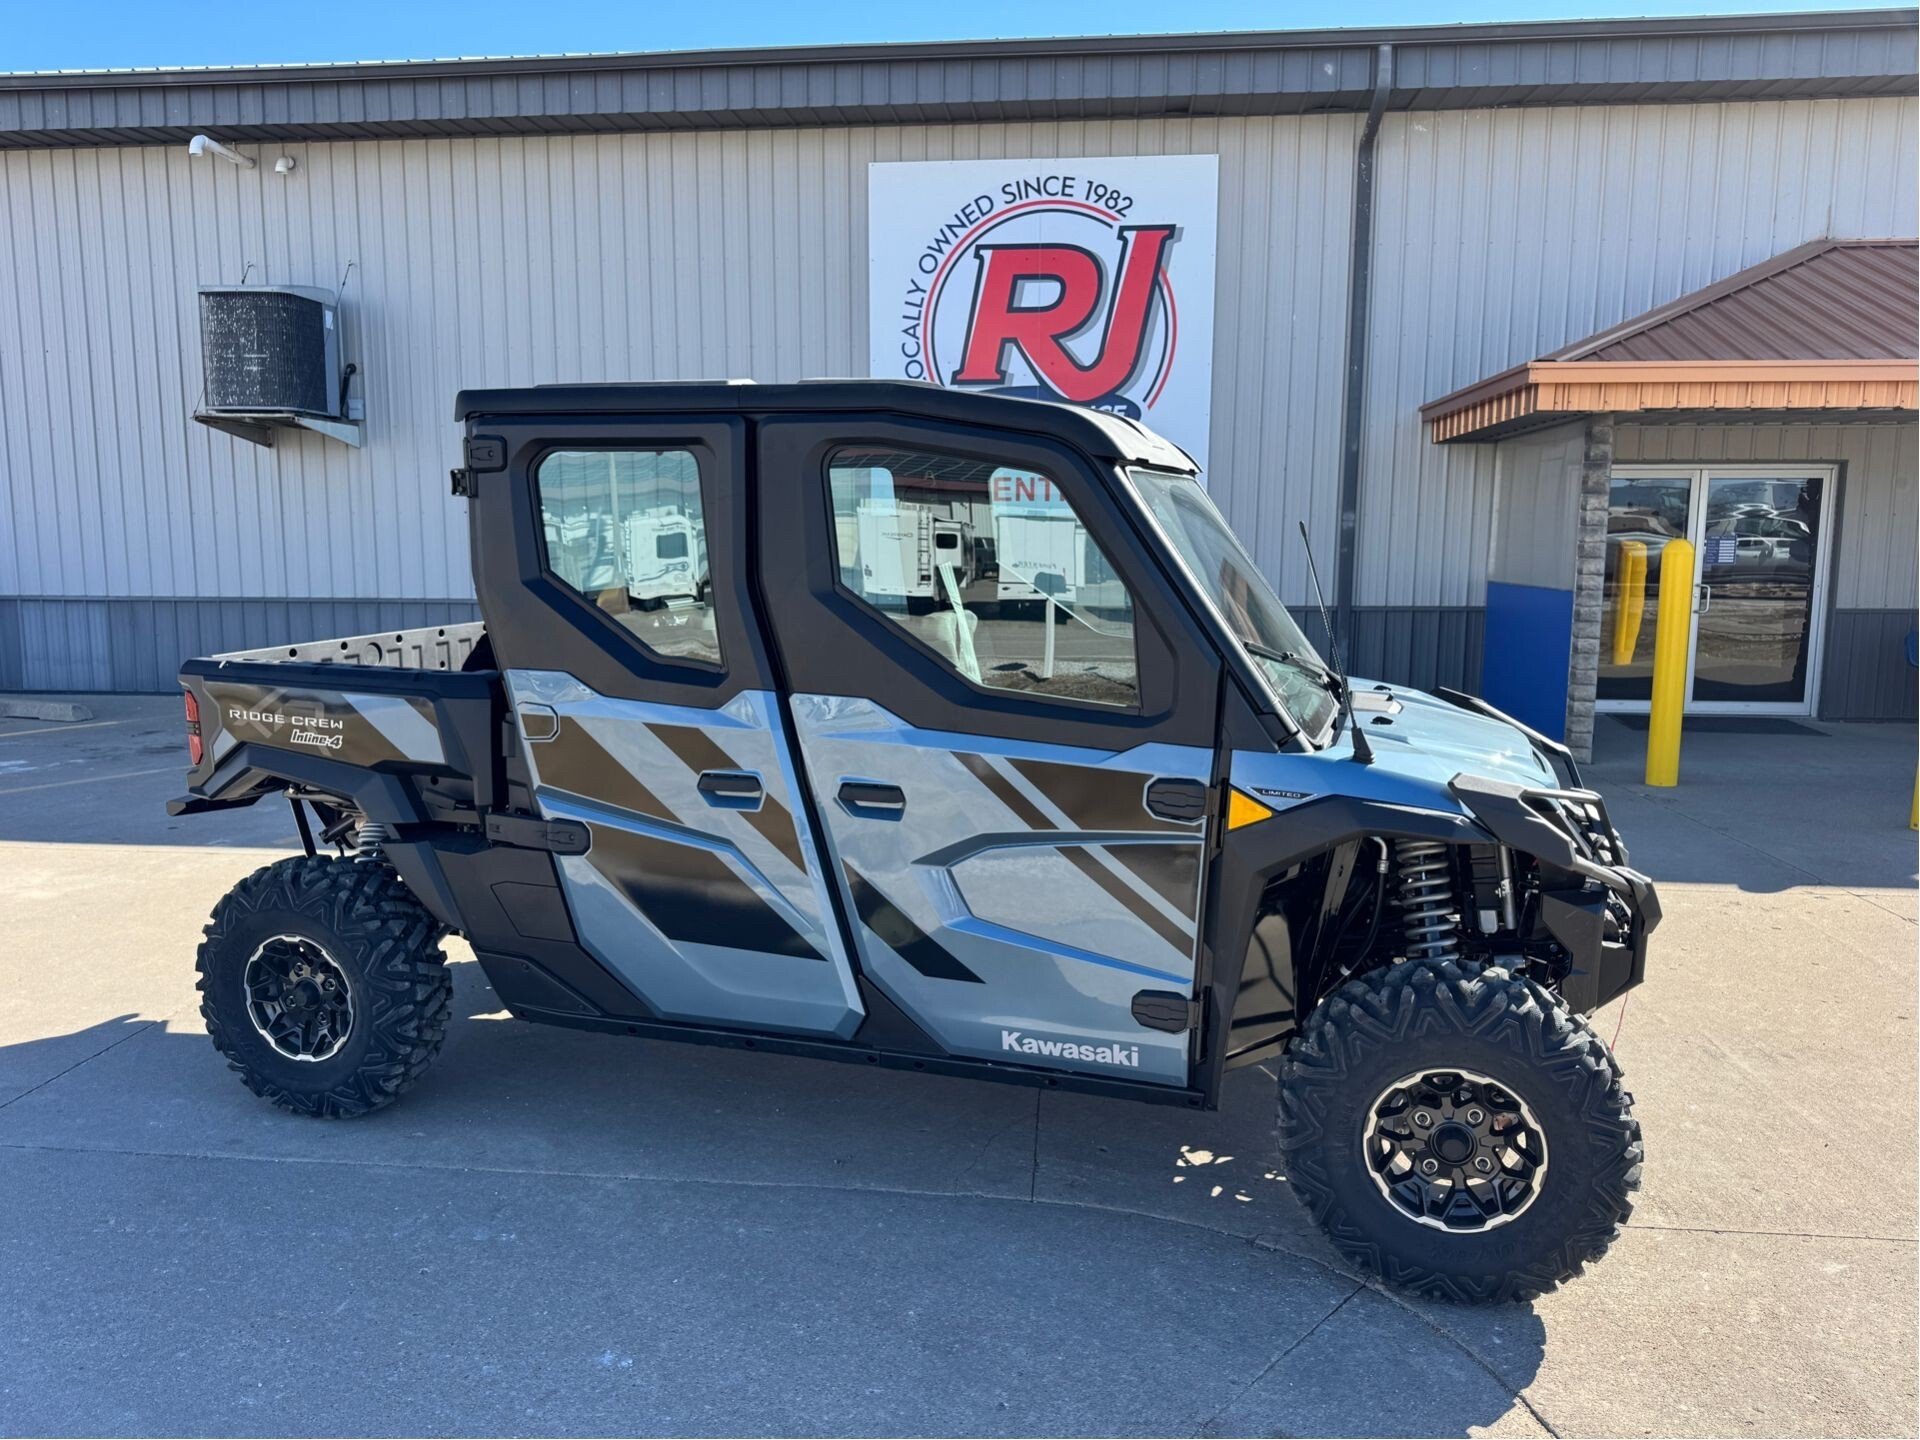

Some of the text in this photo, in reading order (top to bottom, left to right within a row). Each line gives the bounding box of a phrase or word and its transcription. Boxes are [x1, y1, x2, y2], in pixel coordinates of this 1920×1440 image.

[900, 175, 1134, 382] OCALLY OWNED SINCE 1982
[951, 224, 1181, 403] RJ
[993, 476, 1066, 502] ENT
[229, 709, 343, 730] RIDGE CREW
[290, 729, 343, 749] Inline-4
[1261, 789, 1301, 799] LIMITED
[1001, 1030, 1139, 1067] Kawasaki
